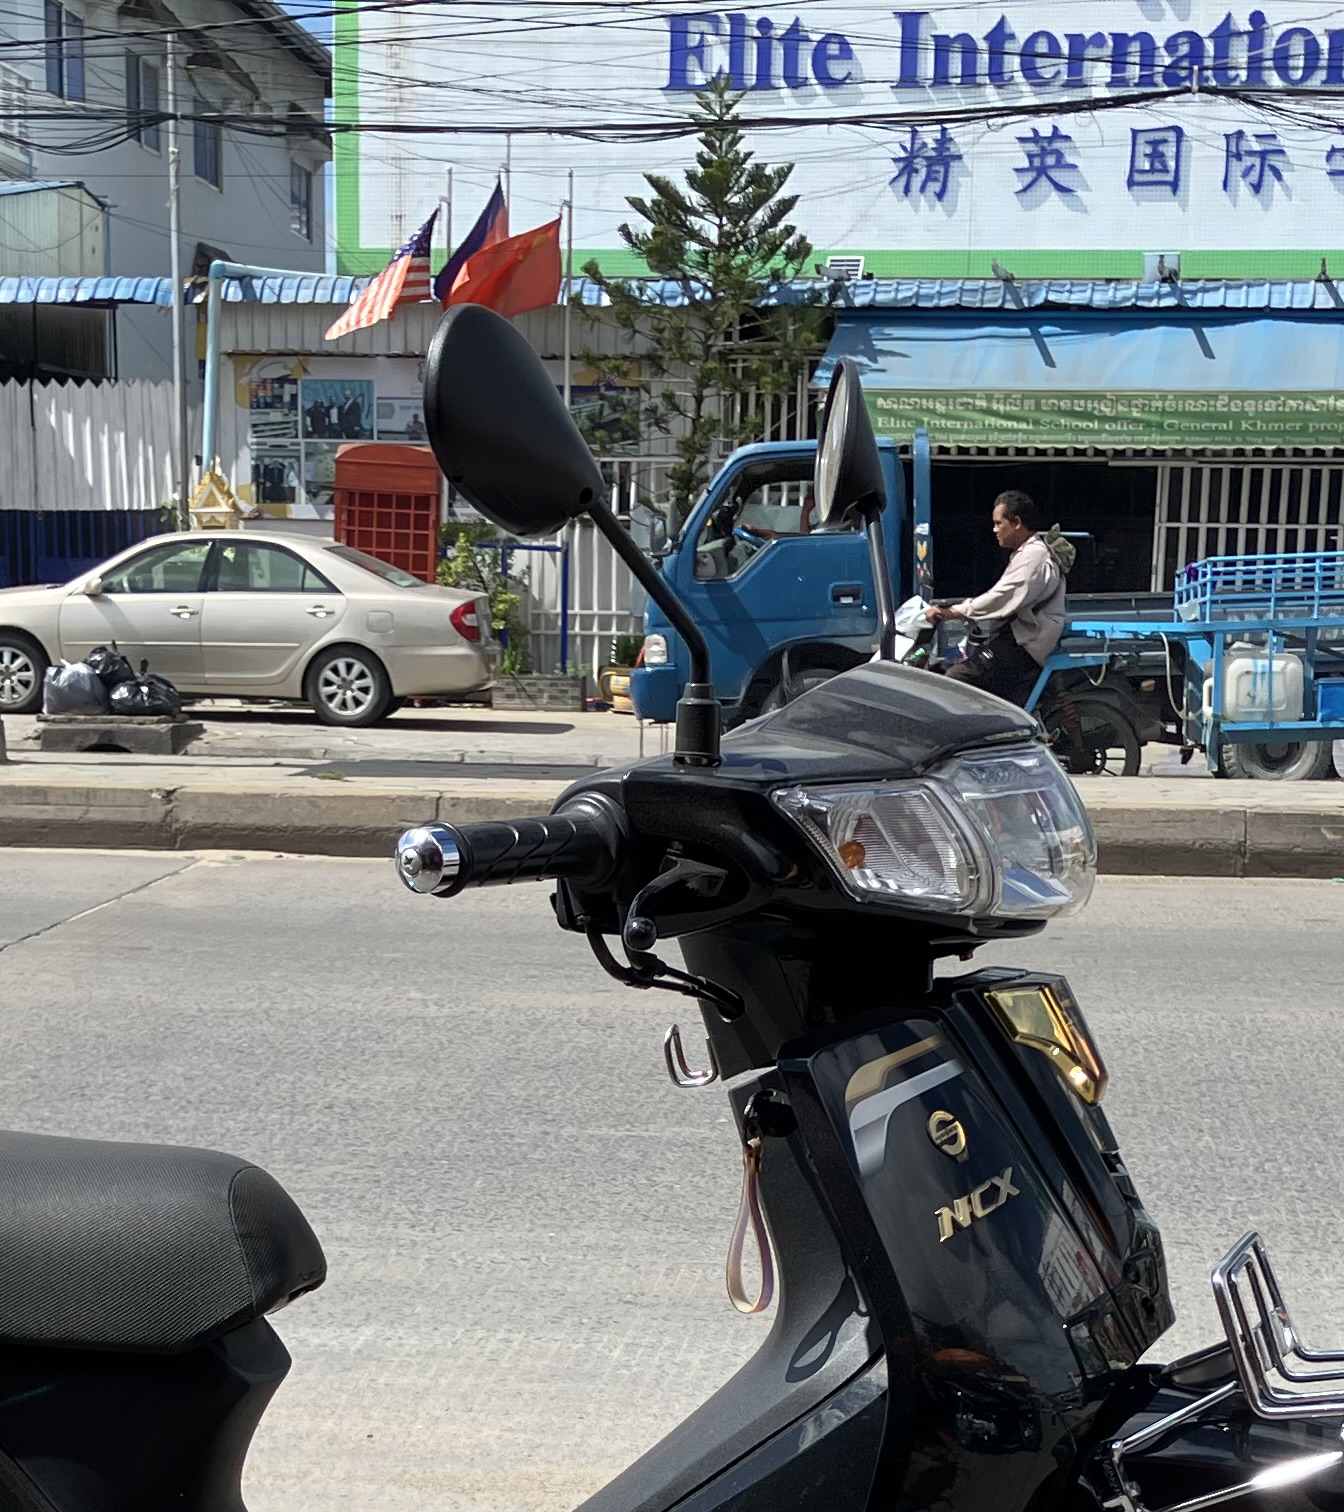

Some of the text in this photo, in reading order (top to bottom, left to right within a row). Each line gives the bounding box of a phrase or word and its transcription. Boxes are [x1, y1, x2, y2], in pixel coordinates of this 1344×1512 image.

[660, 12, 854, 91] Elite
[876, 416, 916, 429] Elite
[922, 416, 1034, 431] International
[1039, 416, 1099, 431] School
[1104, 420, 1146, 431] offer
[1163, 419, 1233, 432] General
[1240, 419, 1303, 432] Khmer
